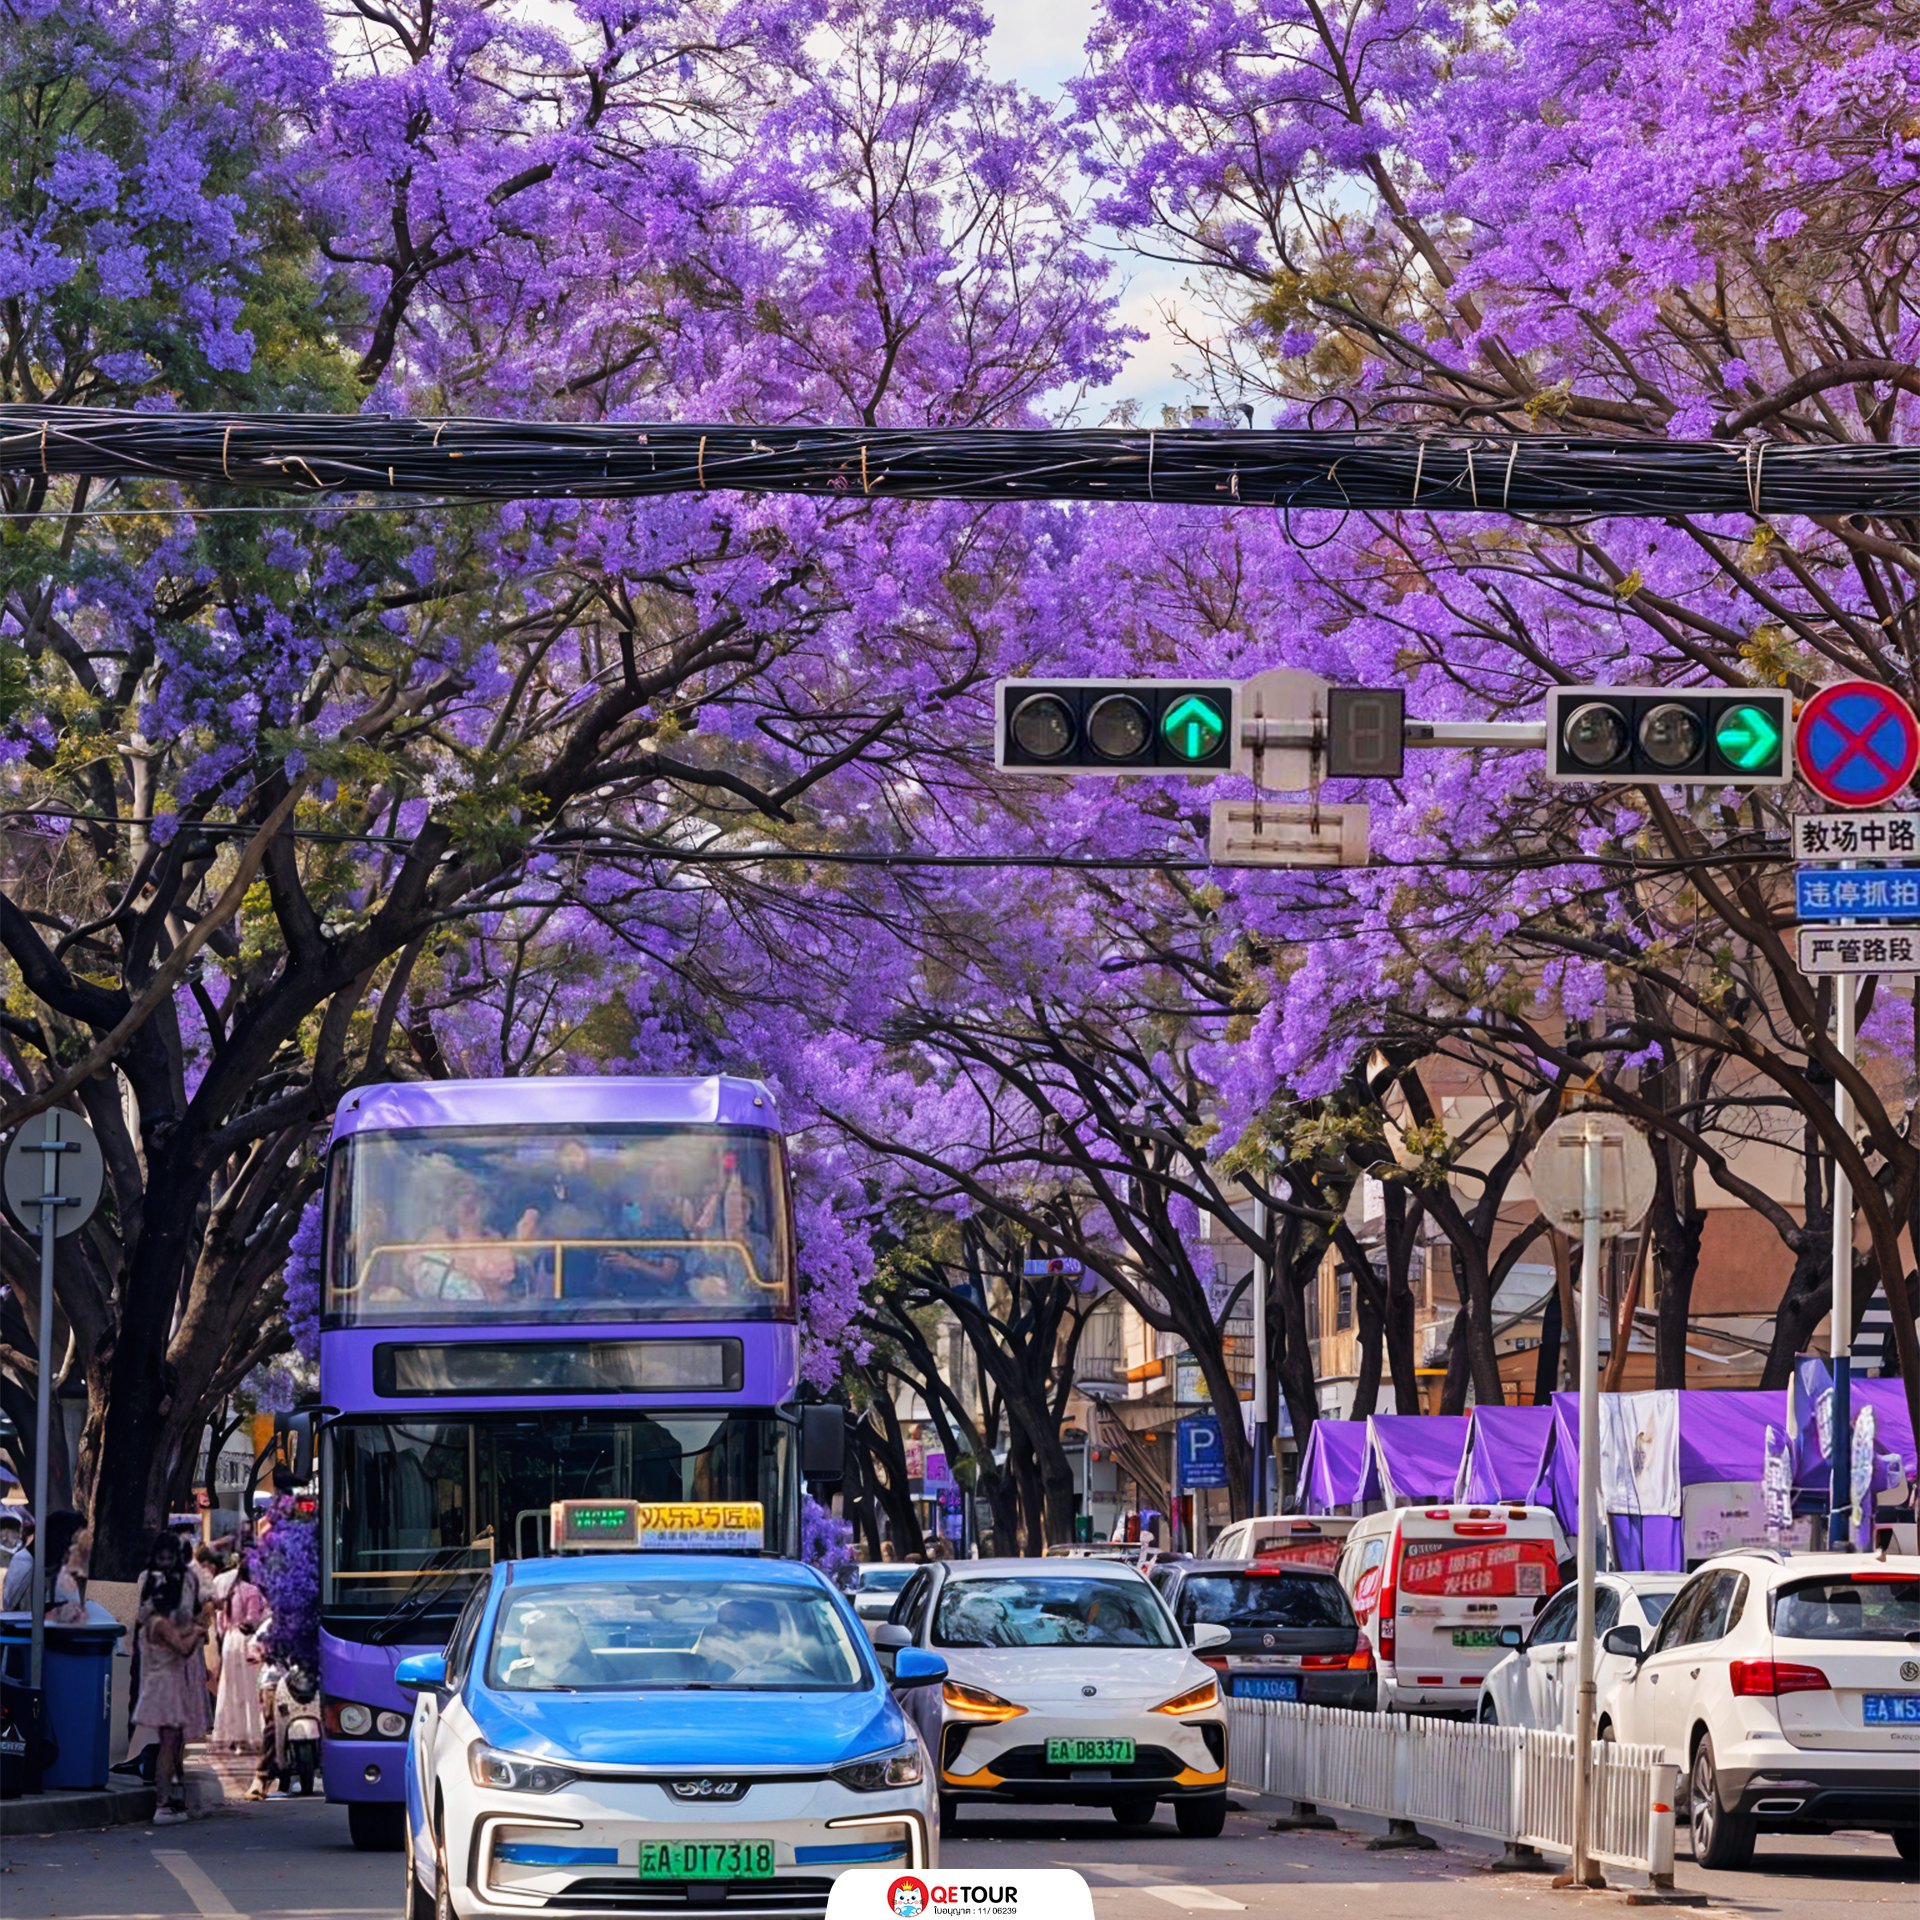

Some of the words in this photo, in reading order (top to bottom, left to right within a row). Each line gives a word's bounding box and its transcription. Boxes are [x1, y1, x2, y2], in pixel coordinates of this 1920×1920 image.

[1802, 820, 1915, 852] 教场中路
[1803, 880, 1919, 909] 违停抓拍
[1812, 937, 1914, 963] 严管路段
[1190, 1428, 1215, 1462] P
[1076, 1741, 1132, 1760] D83371
[684, 1844, 771, 1873] DT7318
